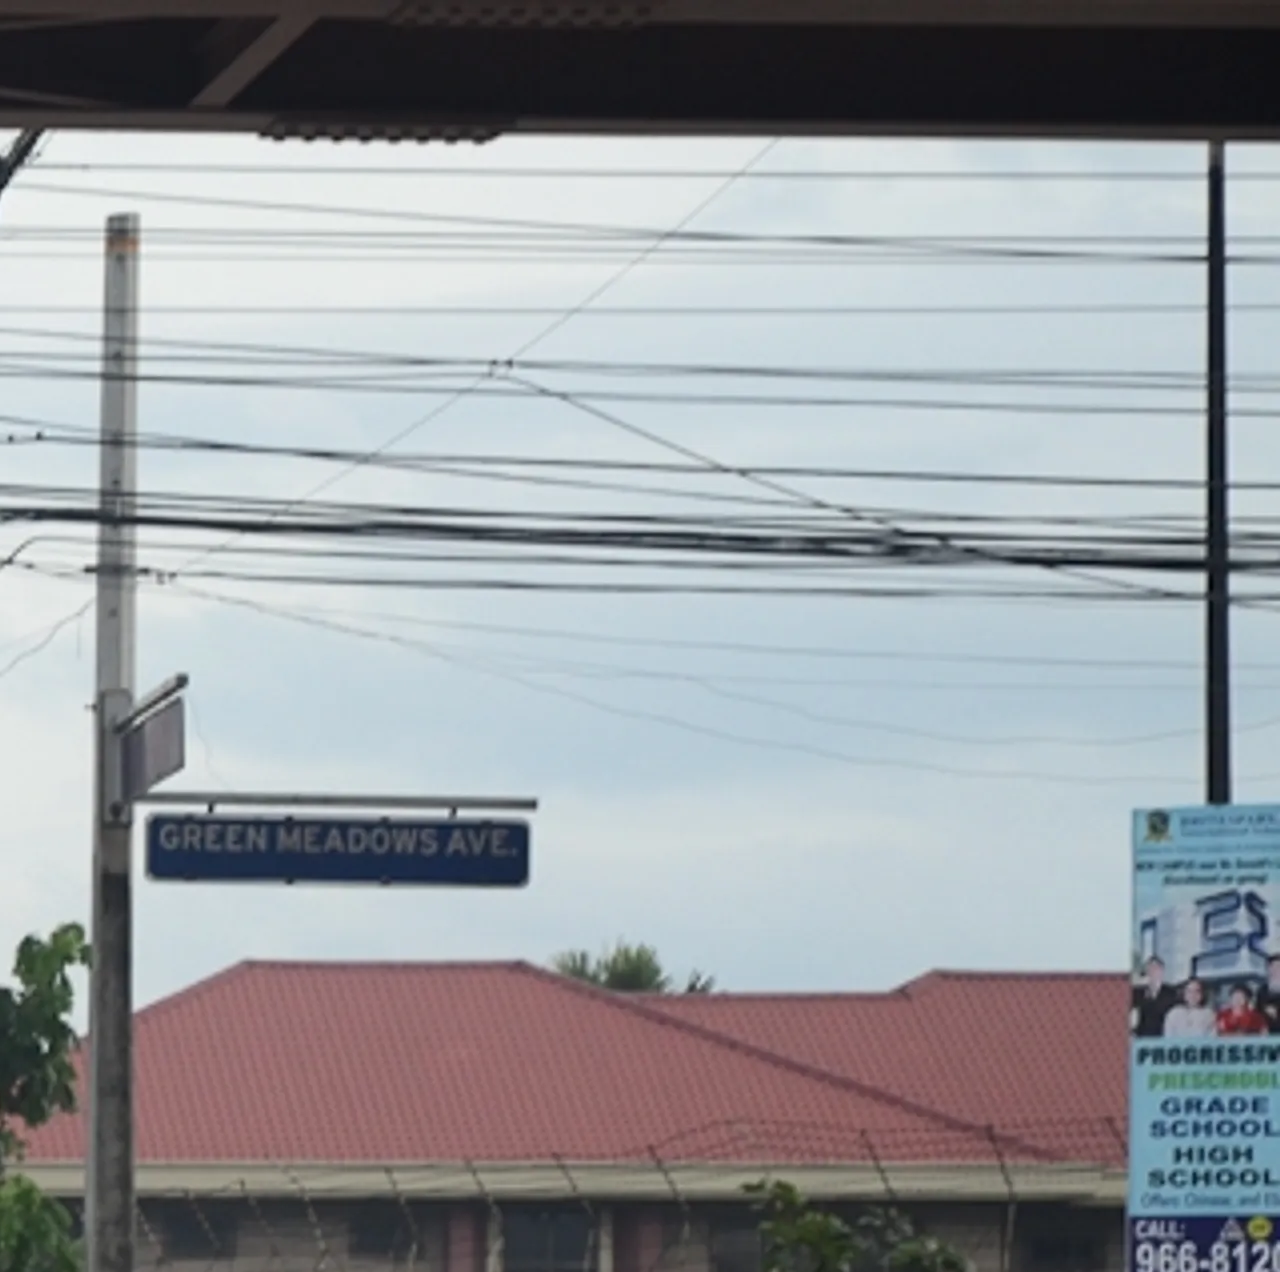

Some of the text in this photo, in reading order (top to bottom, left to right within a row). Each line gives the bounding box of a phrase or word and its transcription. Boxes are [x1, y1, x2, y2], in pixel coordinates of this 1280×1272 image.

[157, 823, 520, 858] GREEN MEADOWS AVE.
[1147, 1071, 1280, 1092] PRESCHOOL
[1159, 1096, 1270, 1116] GRADE
[1149, 1119, 1280, 1139] SCHOOL
[1173, 1145, 1254, 1165] HIGH
[1146, 1168, 1280, 1189] SCHOOL
[1135, 1219, 1186, 1240] CALL:
